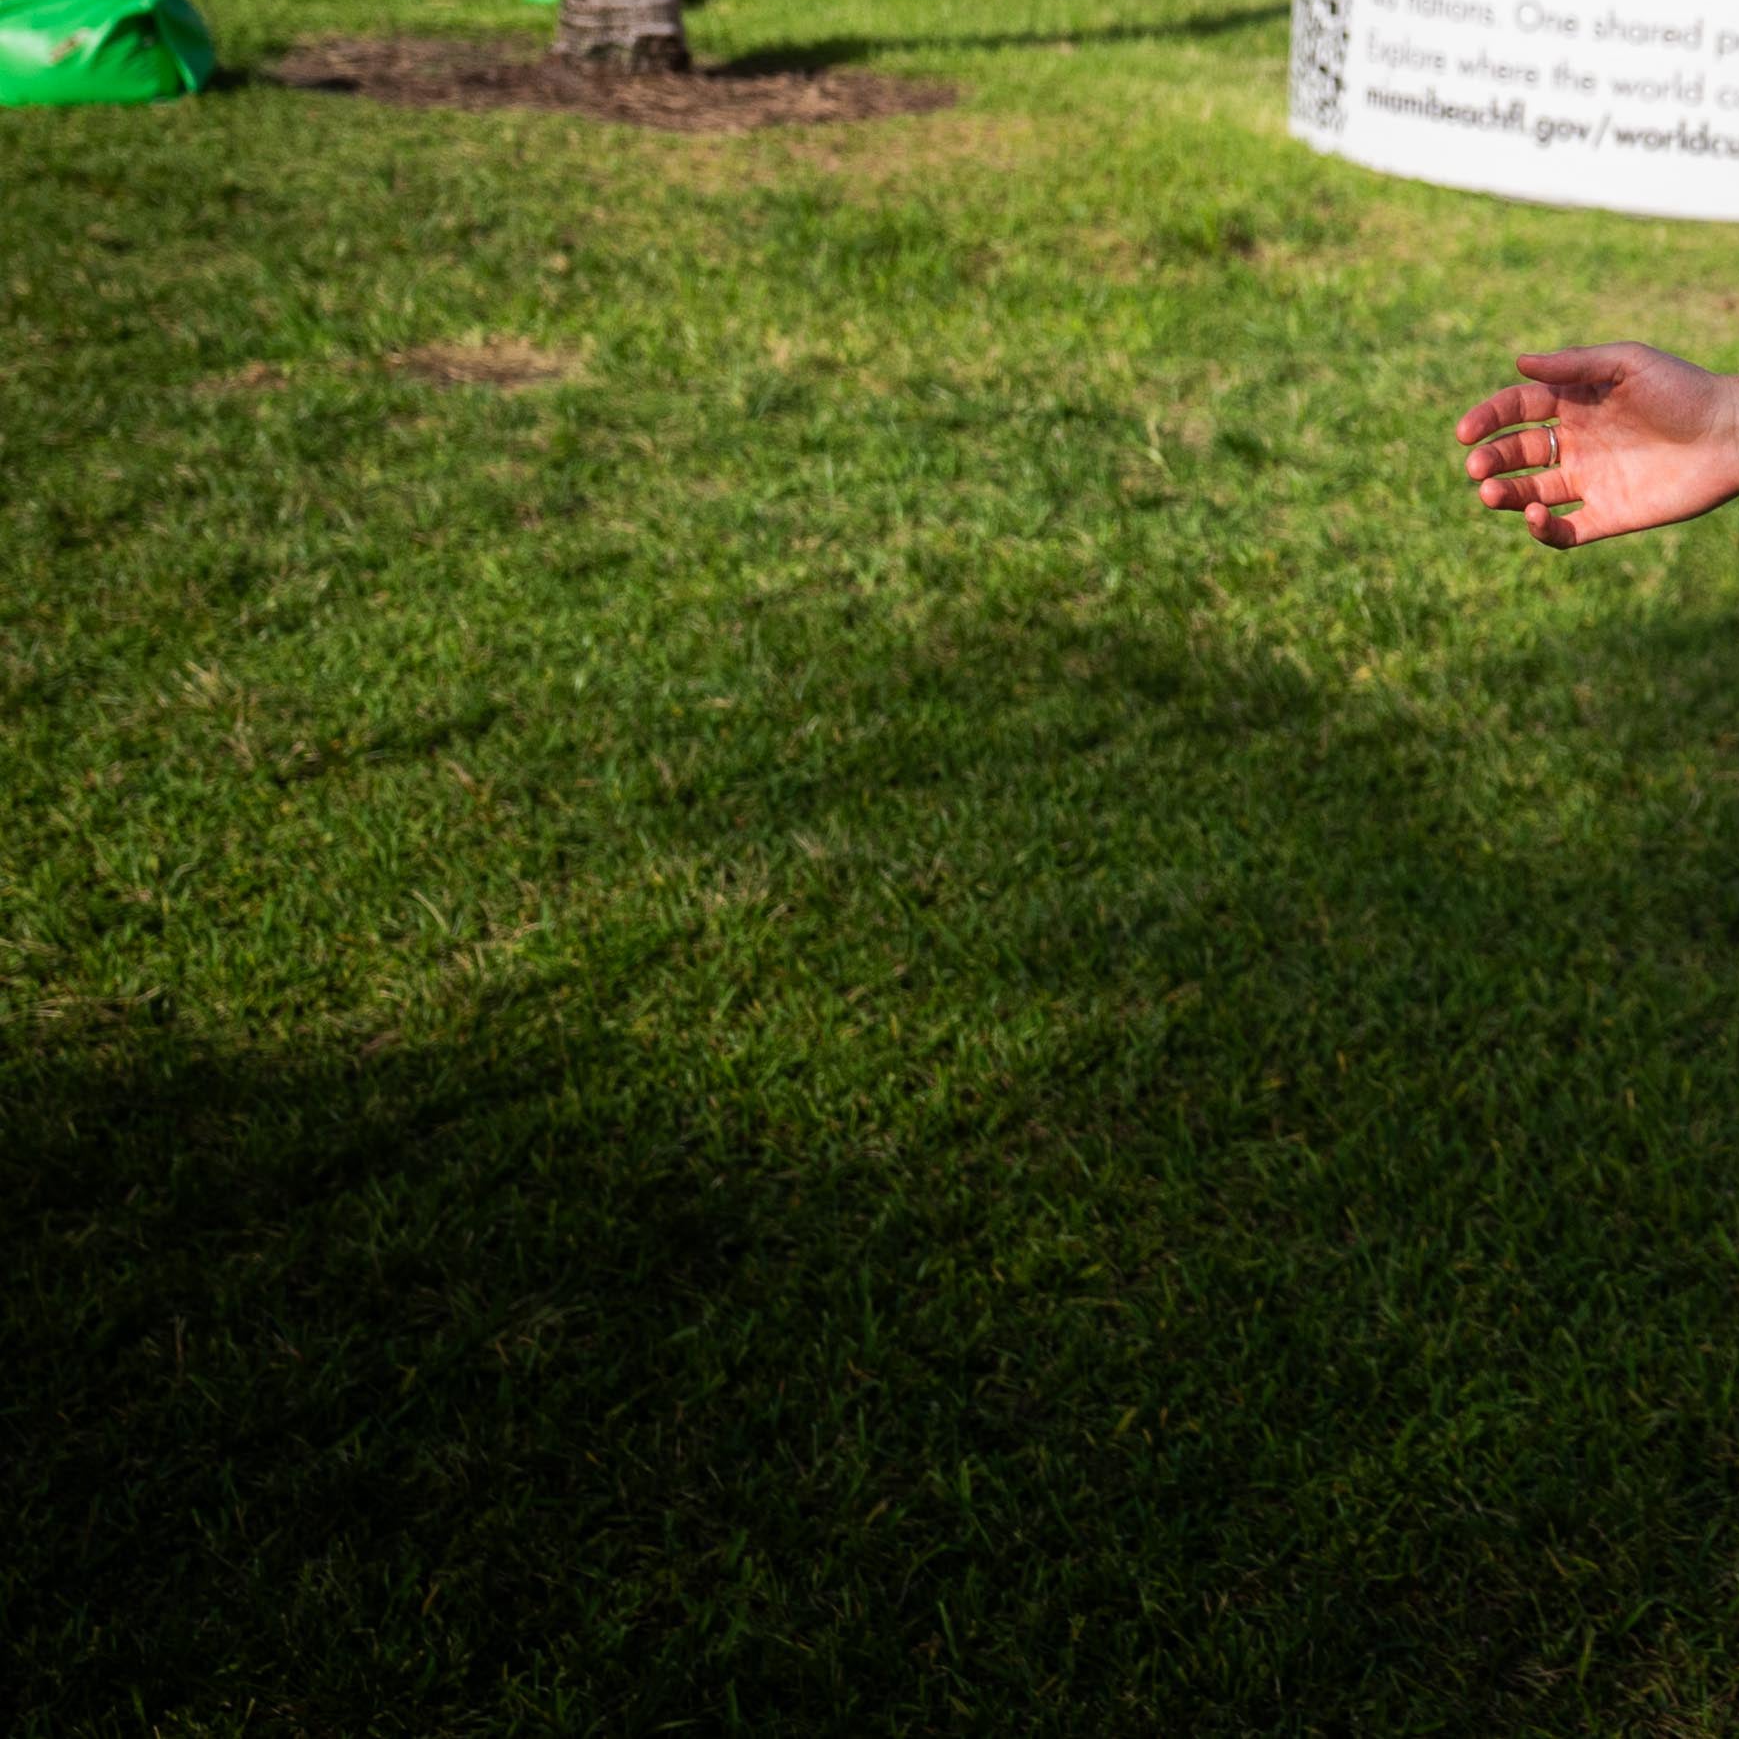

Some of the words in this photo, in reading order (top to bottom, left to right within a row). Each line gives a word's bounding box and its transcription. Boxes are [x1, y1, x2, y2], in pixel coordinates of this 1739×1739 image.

[1594, 9, 1704, 49] shared
[1366, 28, 1447, 75] Explore
[1456, 45, 1541, 85] where
[1553, 58, 1599, 96] the
[1611, 71, 1704, 106] world
